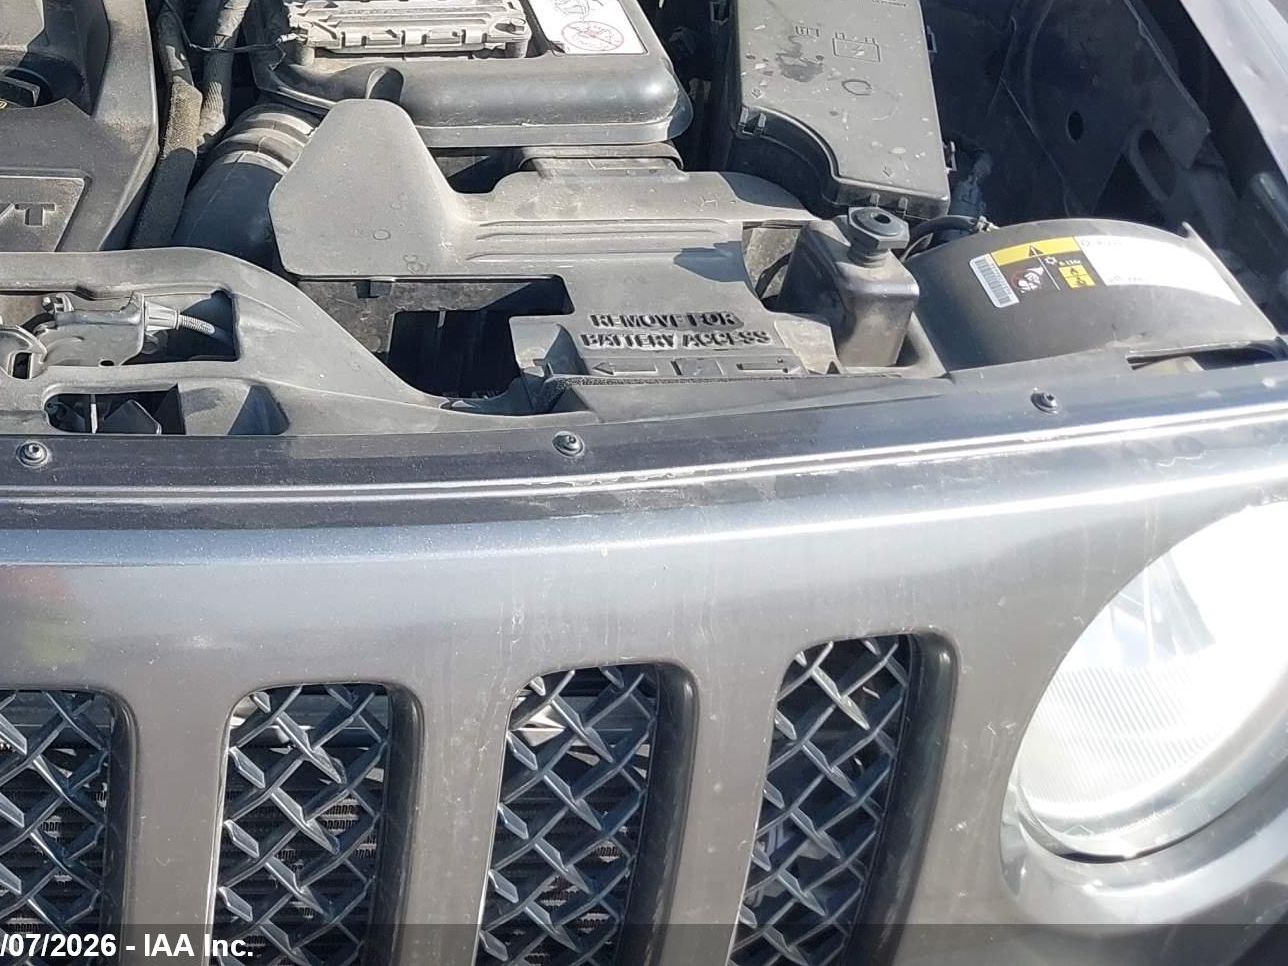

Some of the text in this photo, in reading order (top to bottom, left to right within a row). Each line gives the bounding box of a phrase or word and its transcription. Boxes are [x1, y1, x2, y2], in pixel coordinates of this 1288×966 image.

[589, 311, 736, 329] REMOVE FOR
[579, 330, 772, 350] BATTERY ACCESS
